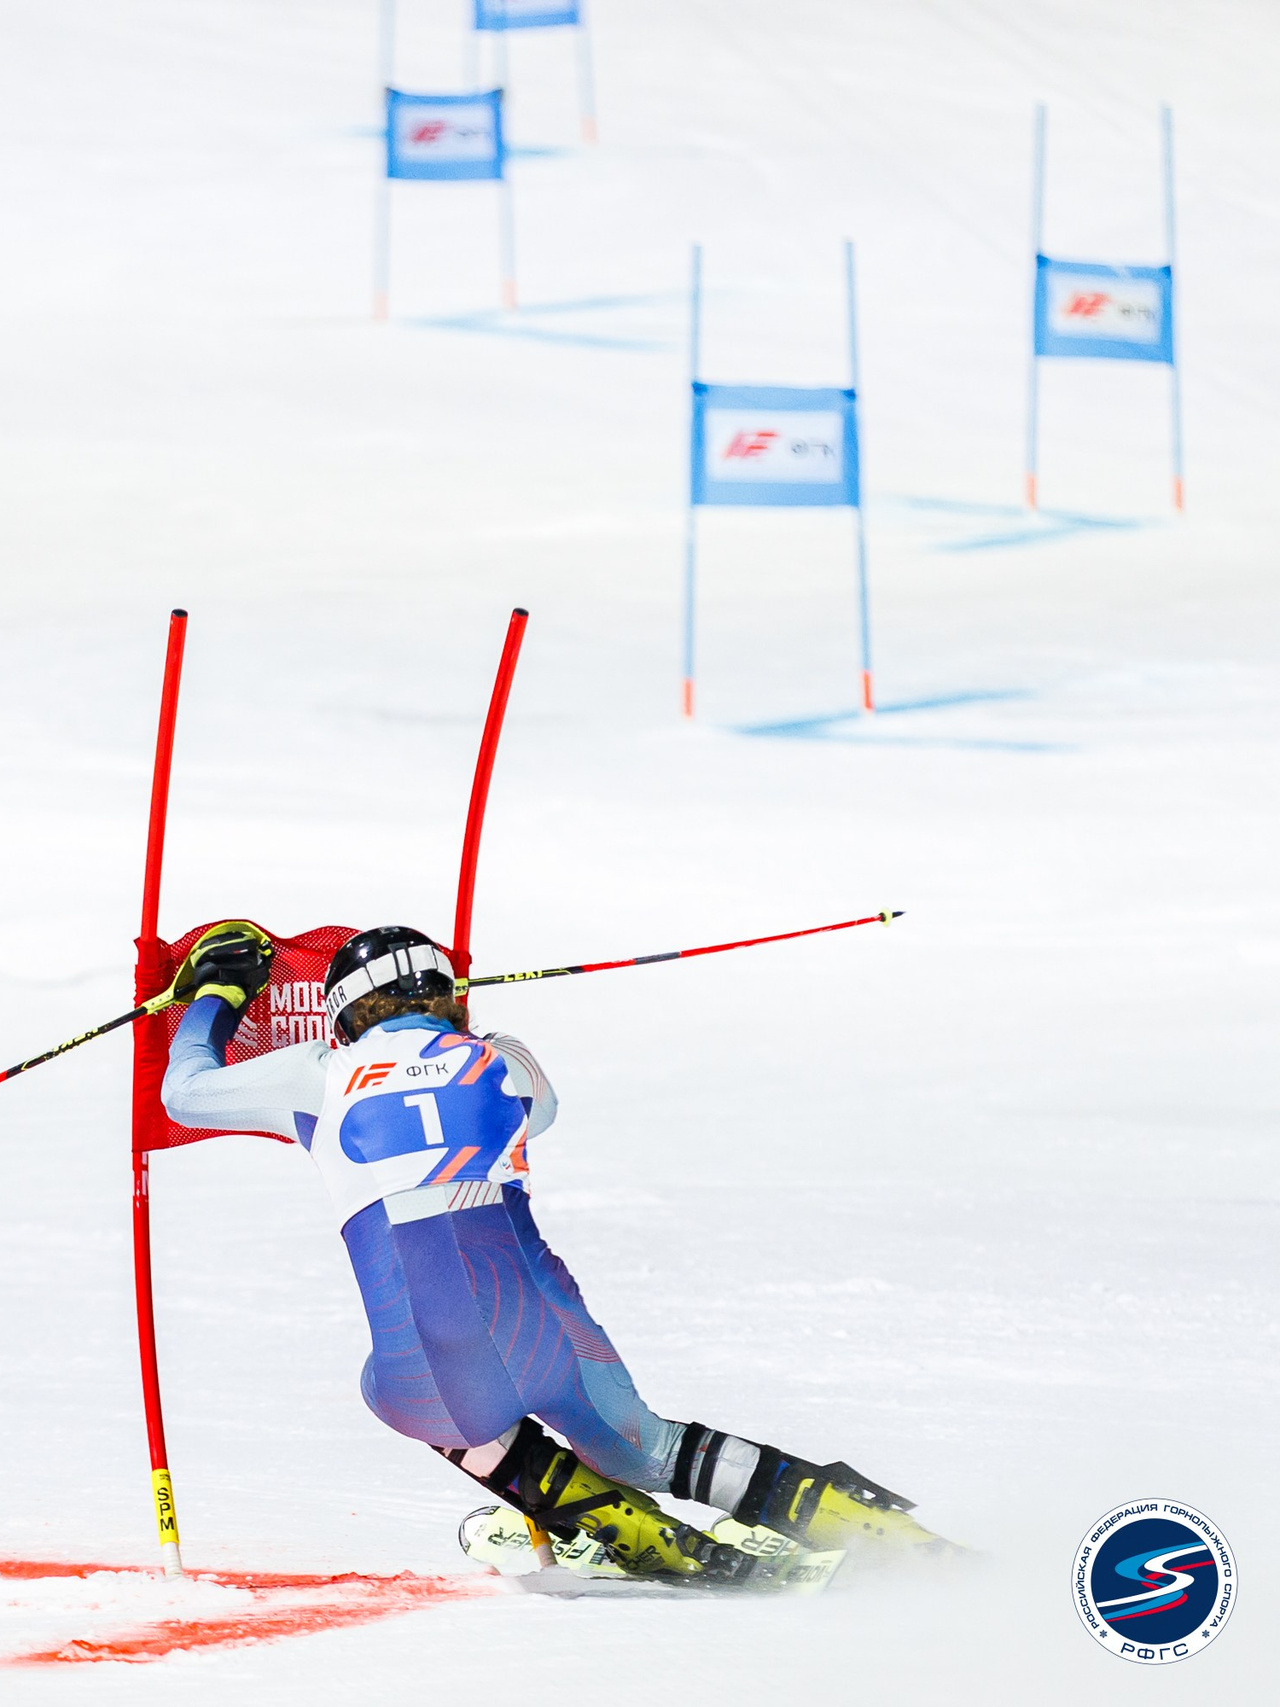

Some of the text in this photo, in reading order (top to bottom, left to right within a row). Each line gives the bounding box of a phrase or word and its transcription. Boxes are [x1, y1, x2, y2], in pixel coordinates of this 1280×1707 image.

[270, 981, 326, 1013] МОС
[406, 1062, 449, 1077] ФГК
[403, 1092, 444, 1146] 1
[157, 1487, 174, 1531] SPM
